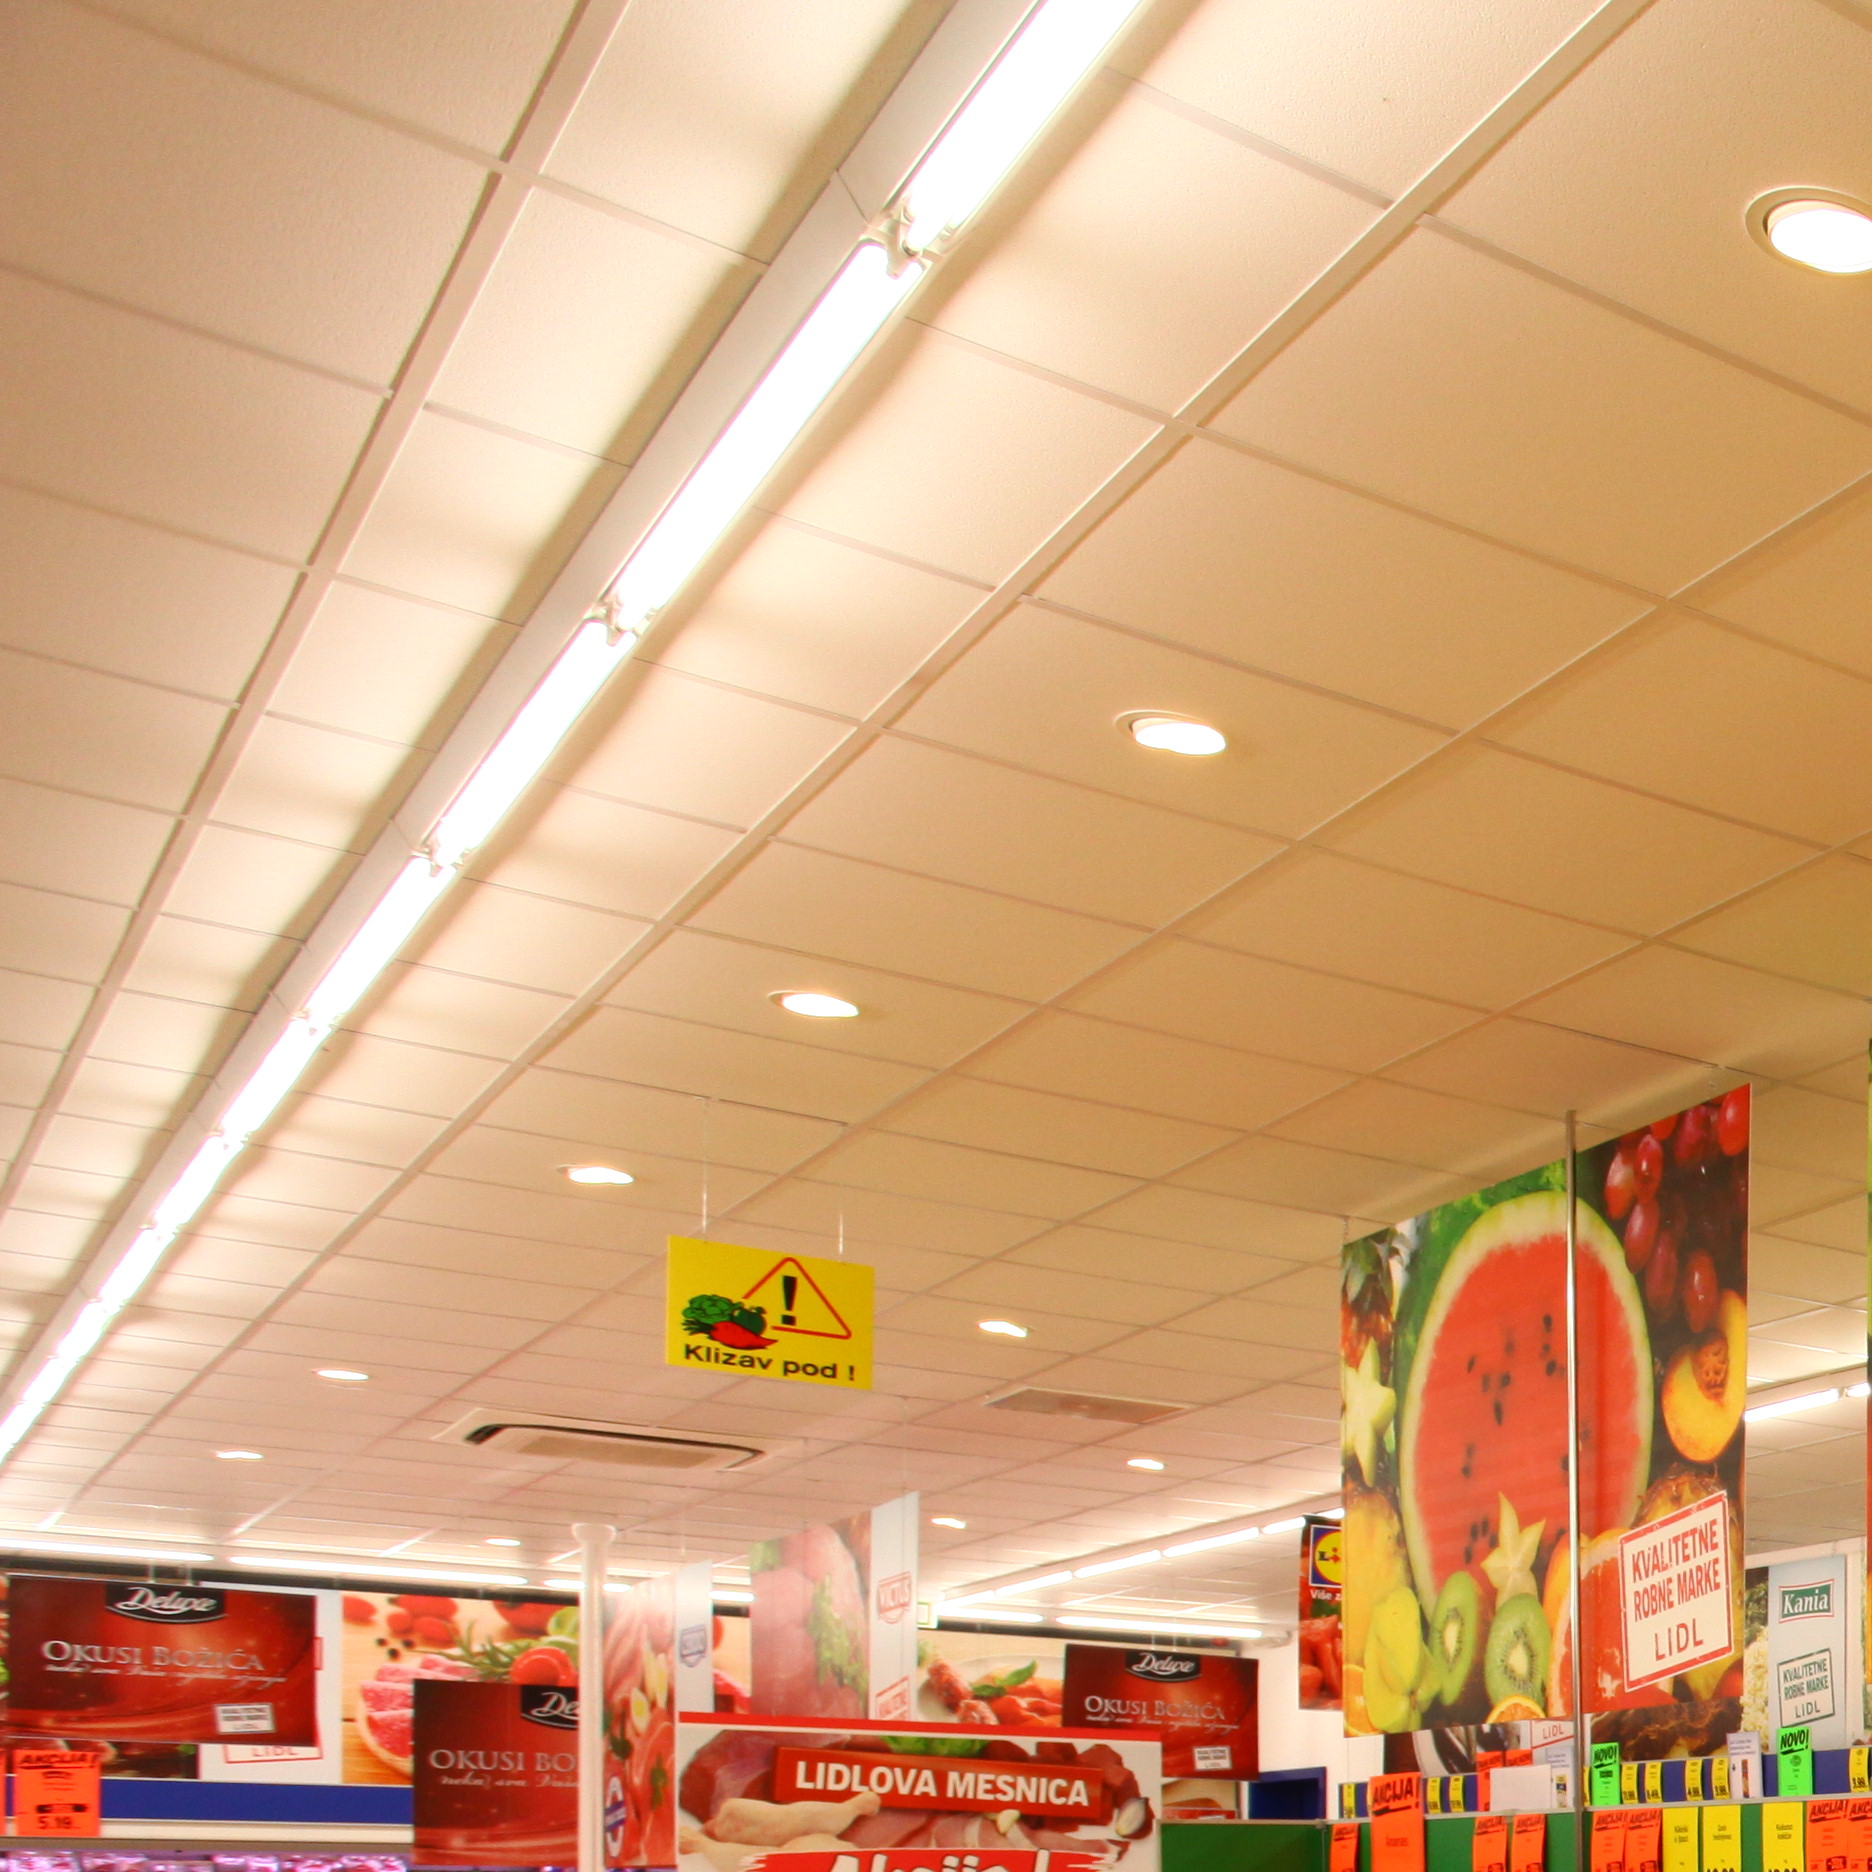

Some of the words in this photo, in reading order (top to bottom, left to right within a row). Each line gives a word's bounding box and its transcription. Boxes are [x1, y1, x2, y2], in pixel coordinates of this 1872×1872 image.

[684, 1343, 773, 1370] Klizav
[783, 1360, 837, 1379] pod
[1632, 1519, 1718, 1583] KVALITETNE
[117, 1587, 216, 1614] Deluxe
[1634, 1578, 1674, 1622] ROBNE
[1677, 1558, 1720, 1605] MARKE
[1783, 1589, 1829, 1616] Kania
[42, 1640, 142, 1664] OKUSI
[1655, 1618, 1703, 1661] LIDL
[1783, 1659, 1827, 1682] KVALITETNE
[1784, 1680, 1805, 1699] ROBNE
[1806, 1675, 1829, 1694] MARKE
[1795, 1700, 1820, 1718] LIDL
[1781, 1730, 1809, 1750] NOVO!
[796, 1761, 937, 1798] LIDLOVA
[946, 1770, 1088, 1806] MESNICA
[1373, 1778, 1420, 1809] AKCIJA!
